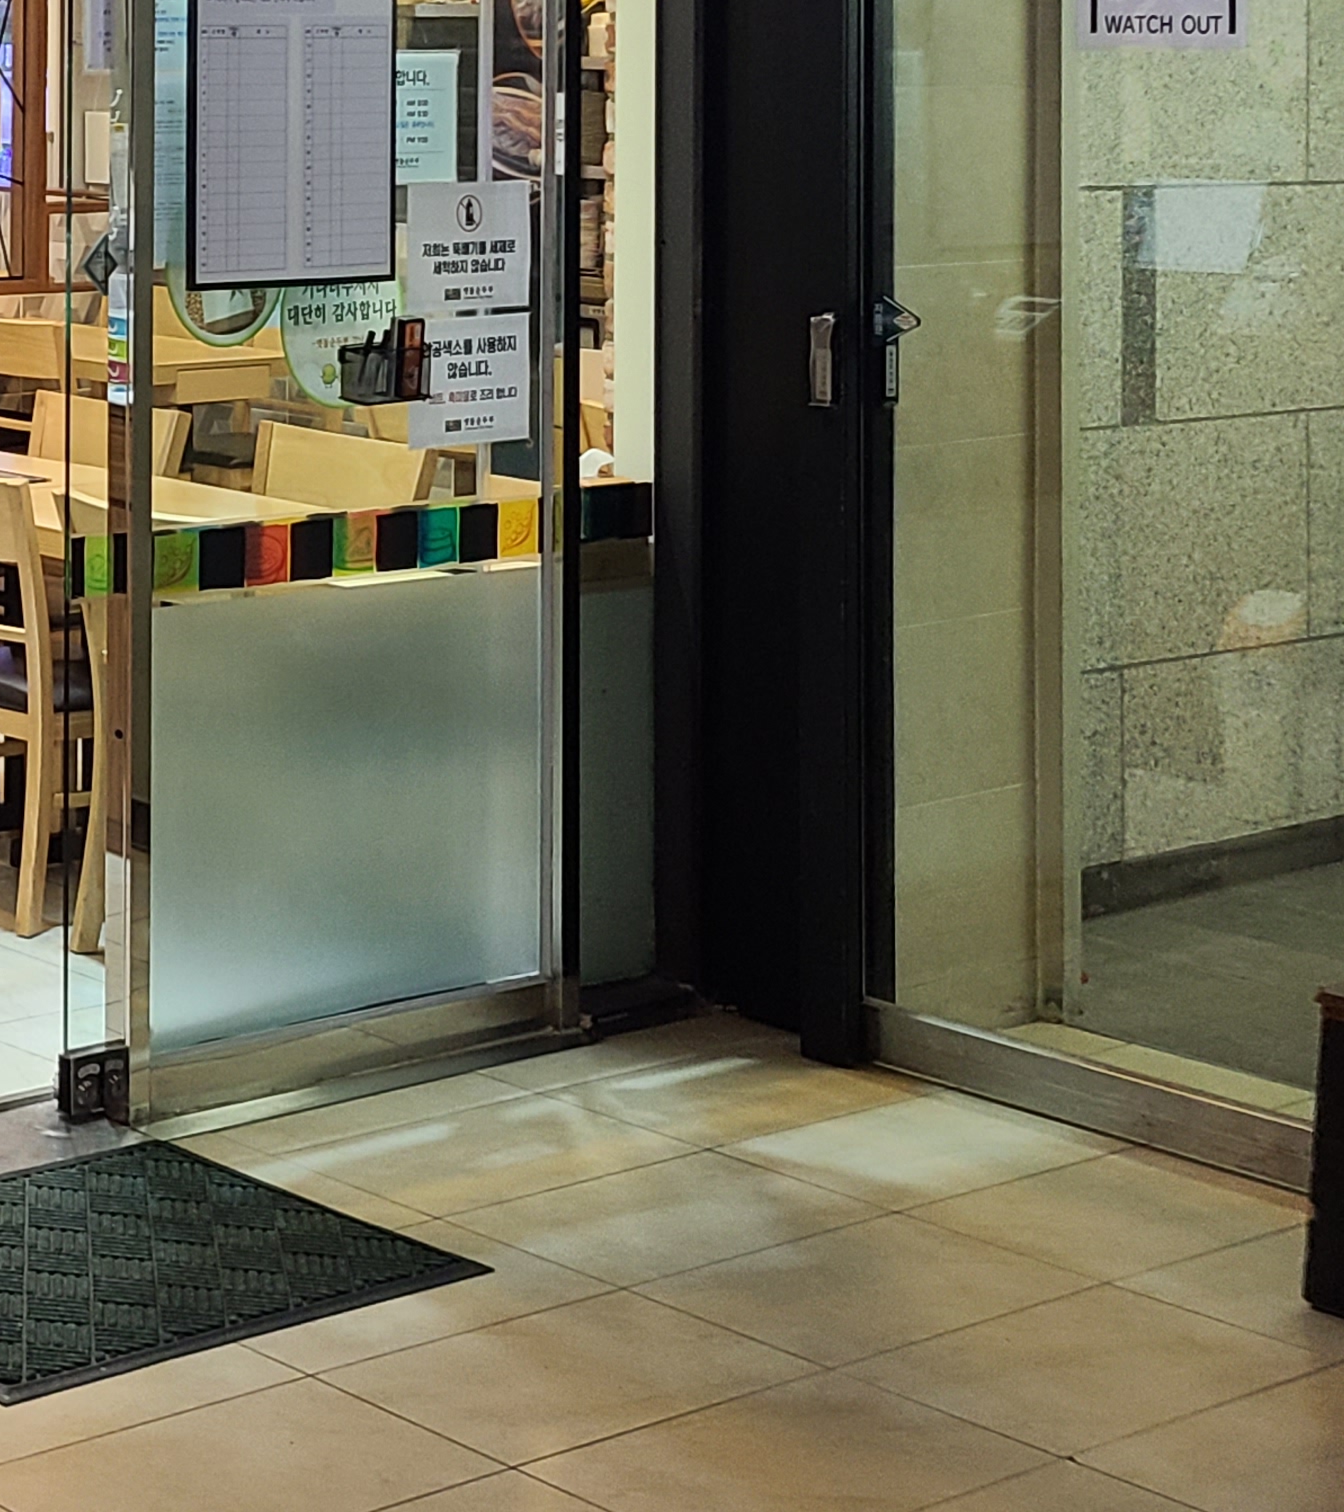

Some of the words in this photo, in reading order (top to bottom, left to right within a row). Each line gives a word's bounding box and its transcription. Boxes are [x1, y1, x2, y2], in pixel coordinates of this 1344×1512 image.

[1104, 14, 1174, 35] WATCH
[1180, 14, 1224, 35] OUT
[286, 303, 327, 326] 대단히
[331, 298, 397, 323] 감사합니다
[475, 335, 518, 355] 사용하지
[446, 359, 493, 380] 않습니다.
